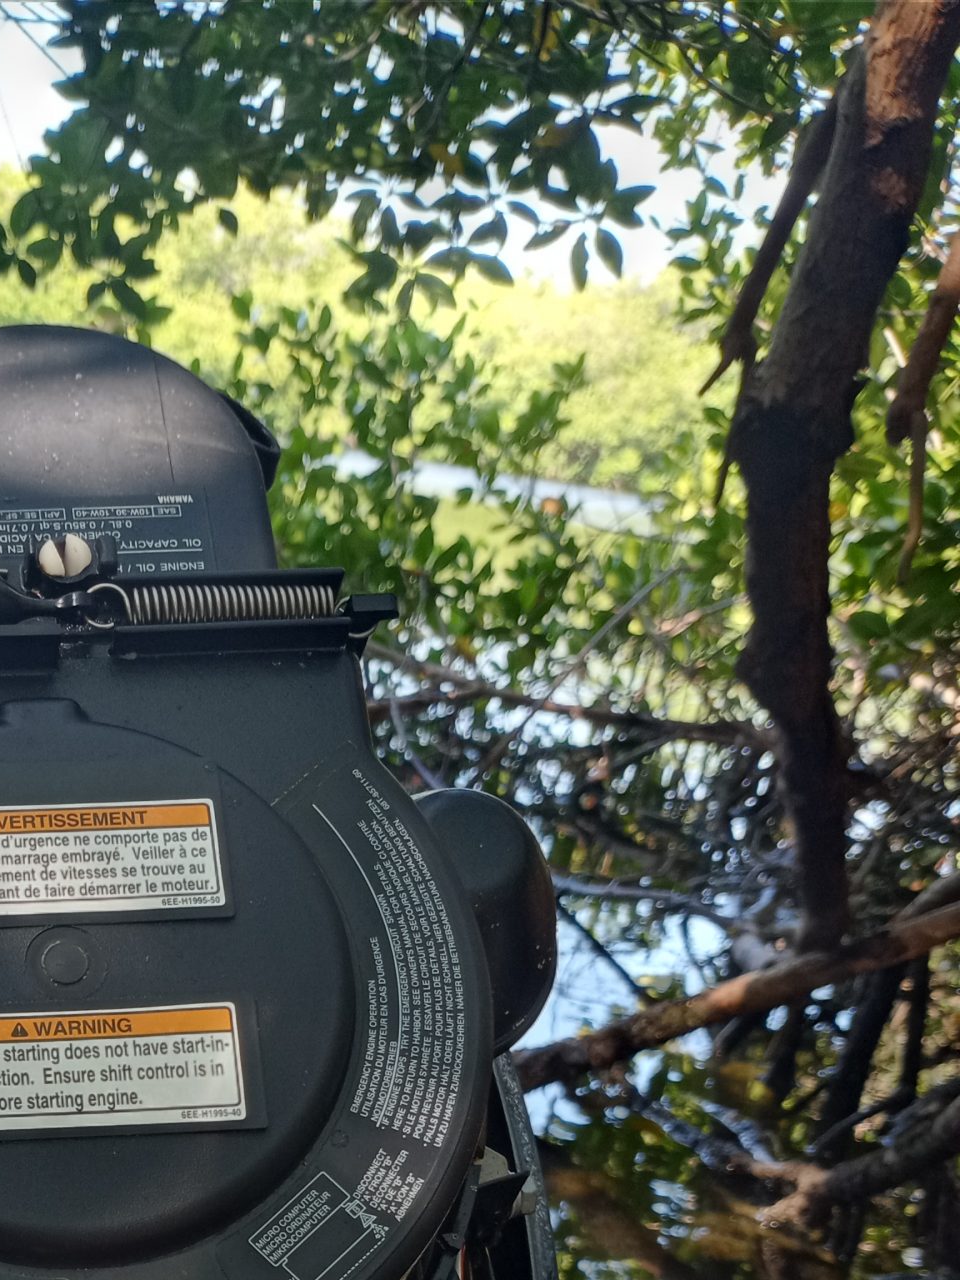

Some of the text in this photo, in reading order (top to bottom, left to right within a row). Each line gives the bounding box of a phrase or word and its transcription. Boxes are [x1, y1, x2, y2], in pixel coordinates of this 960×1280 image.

[1, 835, 70, 852] d'urgence
[73, 835, 90, 846] ne
[94, 831, 161, 849] comporte
[162, 831, 188, 847] pas
[191, 828, 208, 842] de
[61, 846, 126, 865] embrayé.
[131, 845, 175, 861] Veiller
[179, 844, 187, 859] à
[190, 847, 207, 858] ce
[40, 866, 57, 881] de
[60, 866, 118, 880] vitesses
[121, 866, 137, 878] se
[140, 863, 185, 877] trouve
[188, 863, 206, 875] au
[24, 884, 41, 898] de
[44, 883, 75, 898] faire
[79, 882, 142, 896] démarrer
[145, 879, 158, 893] le
[161, 878, 214, 892] moteur.
[32, 1017, 132, 1037] WARNING
[3, 1044, 60, 1064] starting
[64, 1043, 101, 1060] does
[104, 1041, 129, 1058] not
[132, 1040, 168, 1057] have
[172, 1035, 229, 1055] start-in-
[42, 1067, 96, 1085] Ensure
[100, 1064, 133, 1082] shift
[137, 1061, 189, 1080] control
[193, 1063, 207, 1077] is
[210, 1063, 224, 1076] in
[26, 1092, 86, 1115] starting
[87, 1091, 145, 1113] engine.
